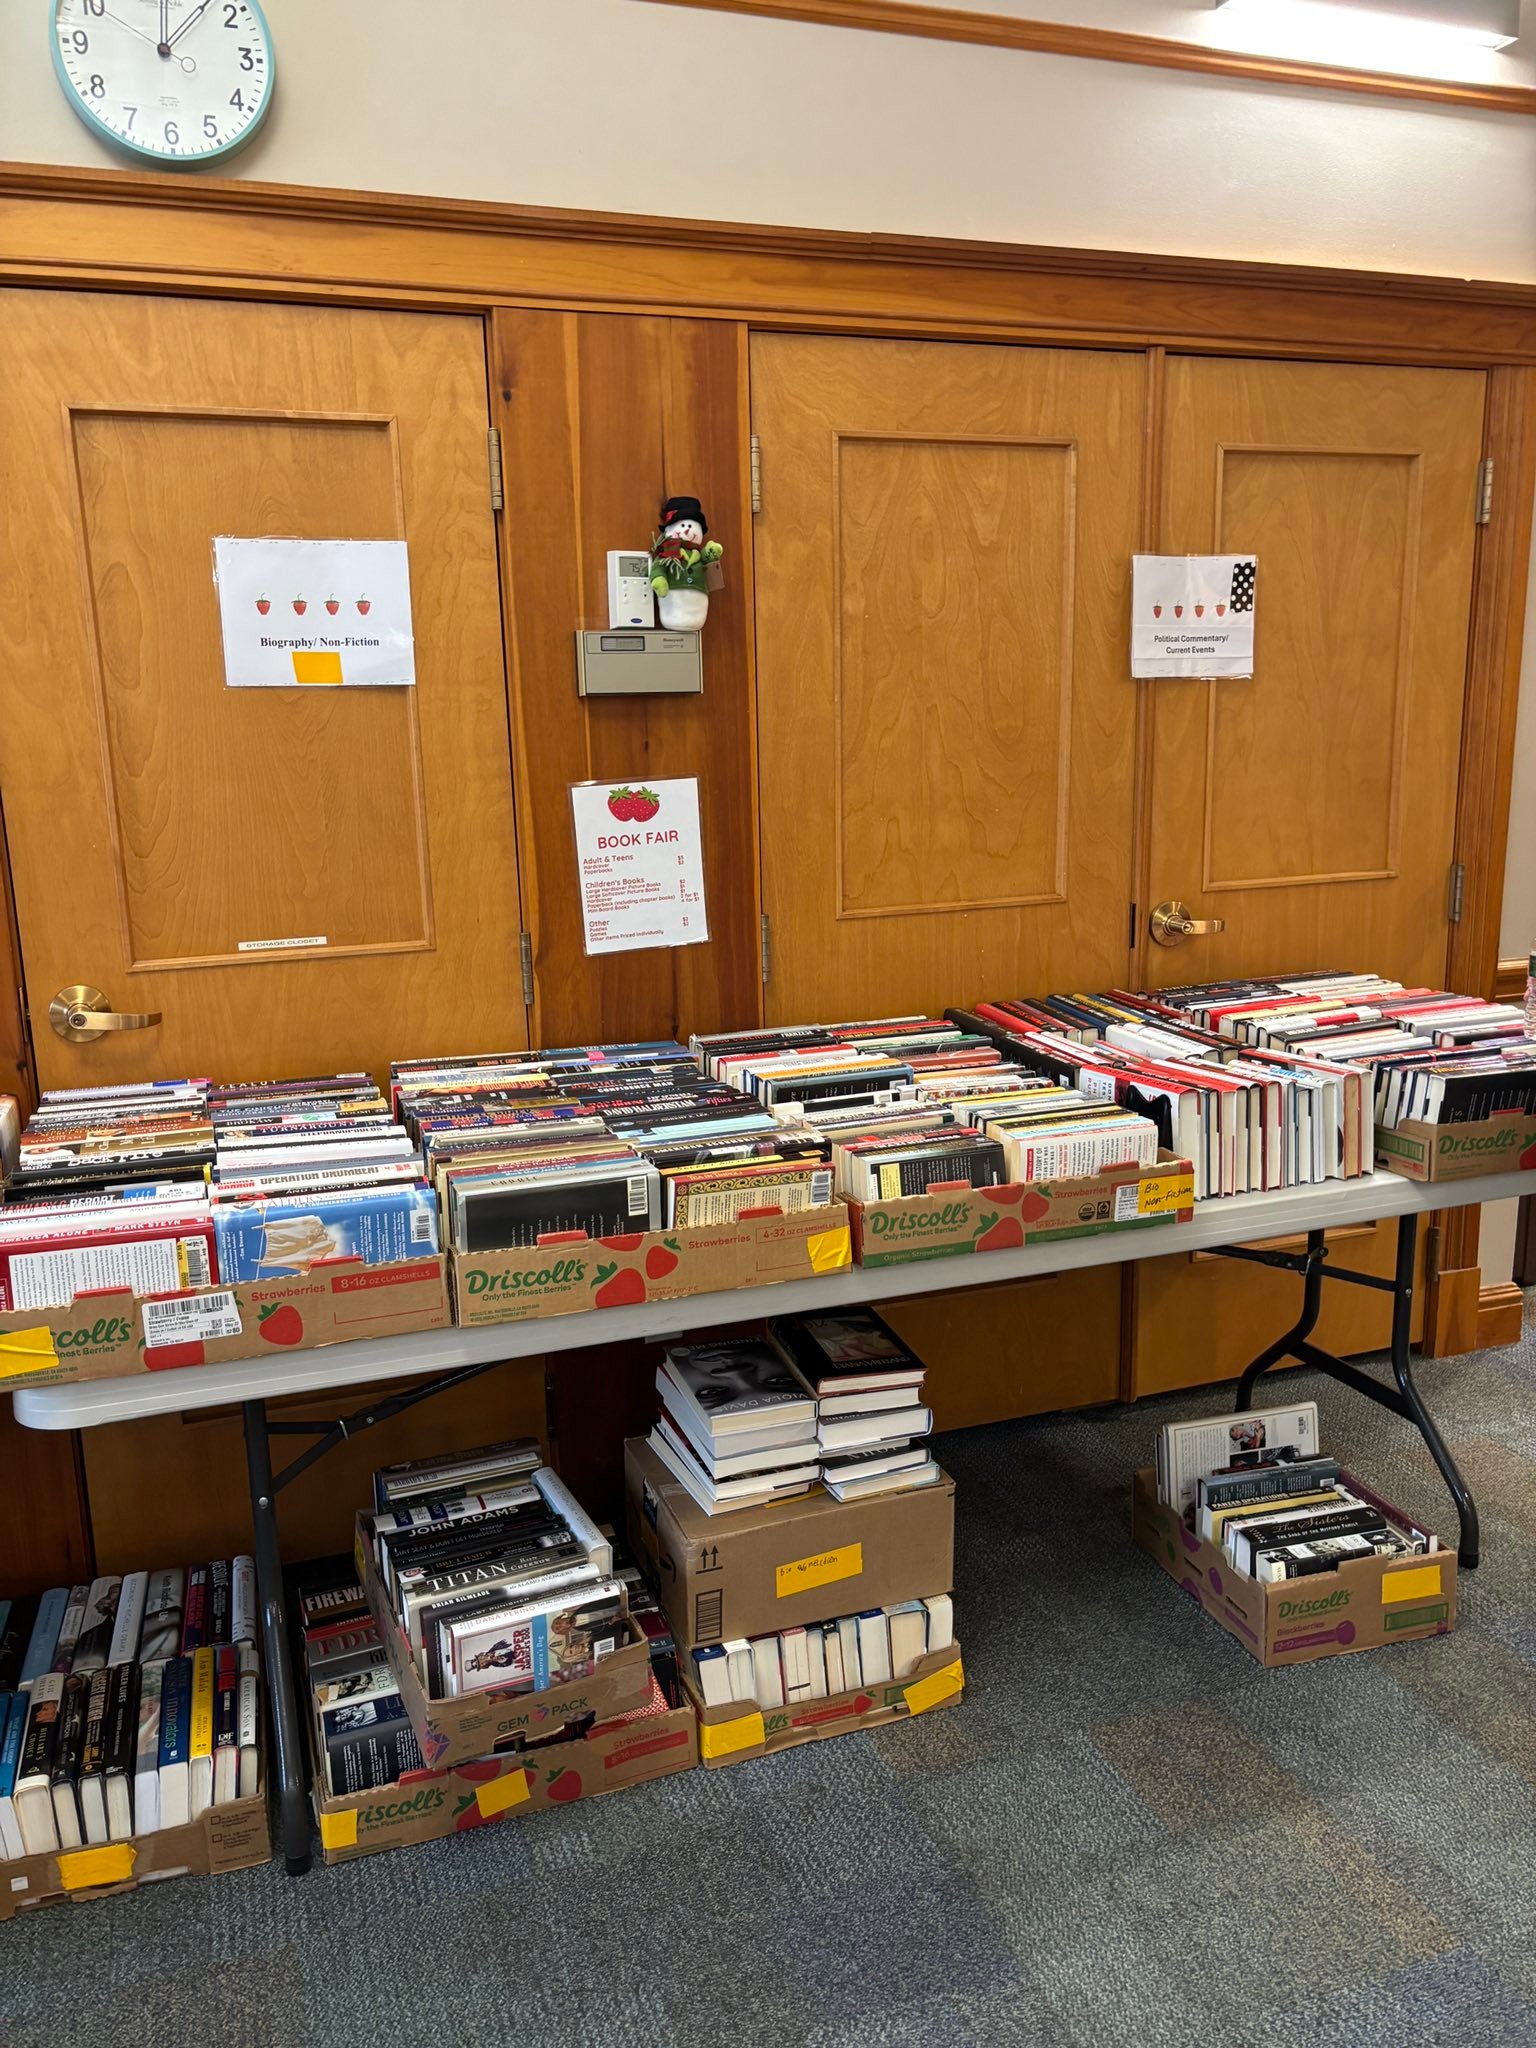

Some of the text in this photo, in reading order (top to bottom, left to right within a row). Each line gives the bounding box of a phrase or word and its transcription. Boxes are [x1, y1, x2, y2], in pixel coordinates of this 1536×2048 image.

[83, 0, 105, 17] 10
[223, 4, 238, 28] 2
[72, 30, 89, 54] 9
[238, 48, 254, 71] 3
[90, 74, 105, 99] 8
[230, 88, 244, 112] 4
[123, 107, 138, 130] 7
[203, 115, 218, 138] 5
[164, 122, 179, 145] 6
[261, 638, 380, 648] Biography/ Non-Fiction
[1154, 634, 1229, 644] Political Commentary/
[598, 830, 679, 849] BOOK FAIR
[583, 857, 603, 865] Adult
[613, 854, 634, 862] Teens
[586, 879, 622, 889] Children's
[589, 920, 609, 928] Other
[597, 1085, 652, 1093] CONFIDENCE
[603, 1106, 634, 1117] DAVID
[634, 1099, 697, 1114] HALBERSTAM
[262, 1121, 358, 1134] TURNAROUND
[1439, 1128, 1518, 1155] Driscoll's
[260, 1172, 320, 1185] OPERATION
[322, 1166, 380, 1179] DRUMBEAT
[1054, 1186, 1108, 1199] Strawberries
[1145, 1183, 1159, 1194] Bio
[870, 1203, 971, 1235] Driscoll's
[54, 1229, 89, 1238] ALONE
[114, 1224, 144, 1232] MARK
[148, 1220, 181, 1228] STEYN
[763, 1222, 837, 1239] 4-32 OZ CLAMSHELLS
[883, 1232, 899, 1241] Only
[900, 1231, 912, 1239] the
[913, 1229, 934, 1238] Finest
[688, 1235, 751, 1250] Strawberries
[884, 1254, 910, 1262] Organic
[340, 1270, 431, 1289] 8-16 OZ CLAMSHELLS
[465, 1258, 587, 1295] Driscoll's
[251, 1283, 326, 1302] Strawberries
[482, 1292, 502, 1302] Only
[502, 1291, 516, 1299] the
[517, 1289, 543, 1297] Finest
[760, 1392, 809, 1405] VIOLA
[1212, 1493, 1290, 1508] PANZER OPERATIONS
[408, 1506, 520, 1538] JOHN ADAMS
[1298, 1515, 1350, 1530] Sisters
[510, 1557, 551, 1571] CHERNOW
[212, 1560, 230, 1588] RESOLVE
[426, 1562, 508, 1592] TITAN
[305, 1585, 366, 1612] FIREWA
[431, 1598, 455, 1609] BRIAN
[456, 1590, 491, 1602] KILMEADE
[466, 1609, 487, 1617] LAST
[489, 1598, 530, 1610] PUNISHER
[1278, 1589, 1351, 1619] Driscoll's
[475, 1606, 536, 1625] DANA PERINO
[1276, 1621, 1324, 1637] Blackberries
[318, 1629, 382, 1656] FDR
[513, 1629, 524, 1671] JASPER
[118, 1665, 130, 1703] STOLEN LIVES
[198, 1671, 209, 1693] Malala
[242, 1678, 252, 1729] AMERICAN SON
[497, 1714, 530, 1732] GEM
[551, 1698, 588, 1717] PACK
[613, 1727, 670, 1749] Strawberries
